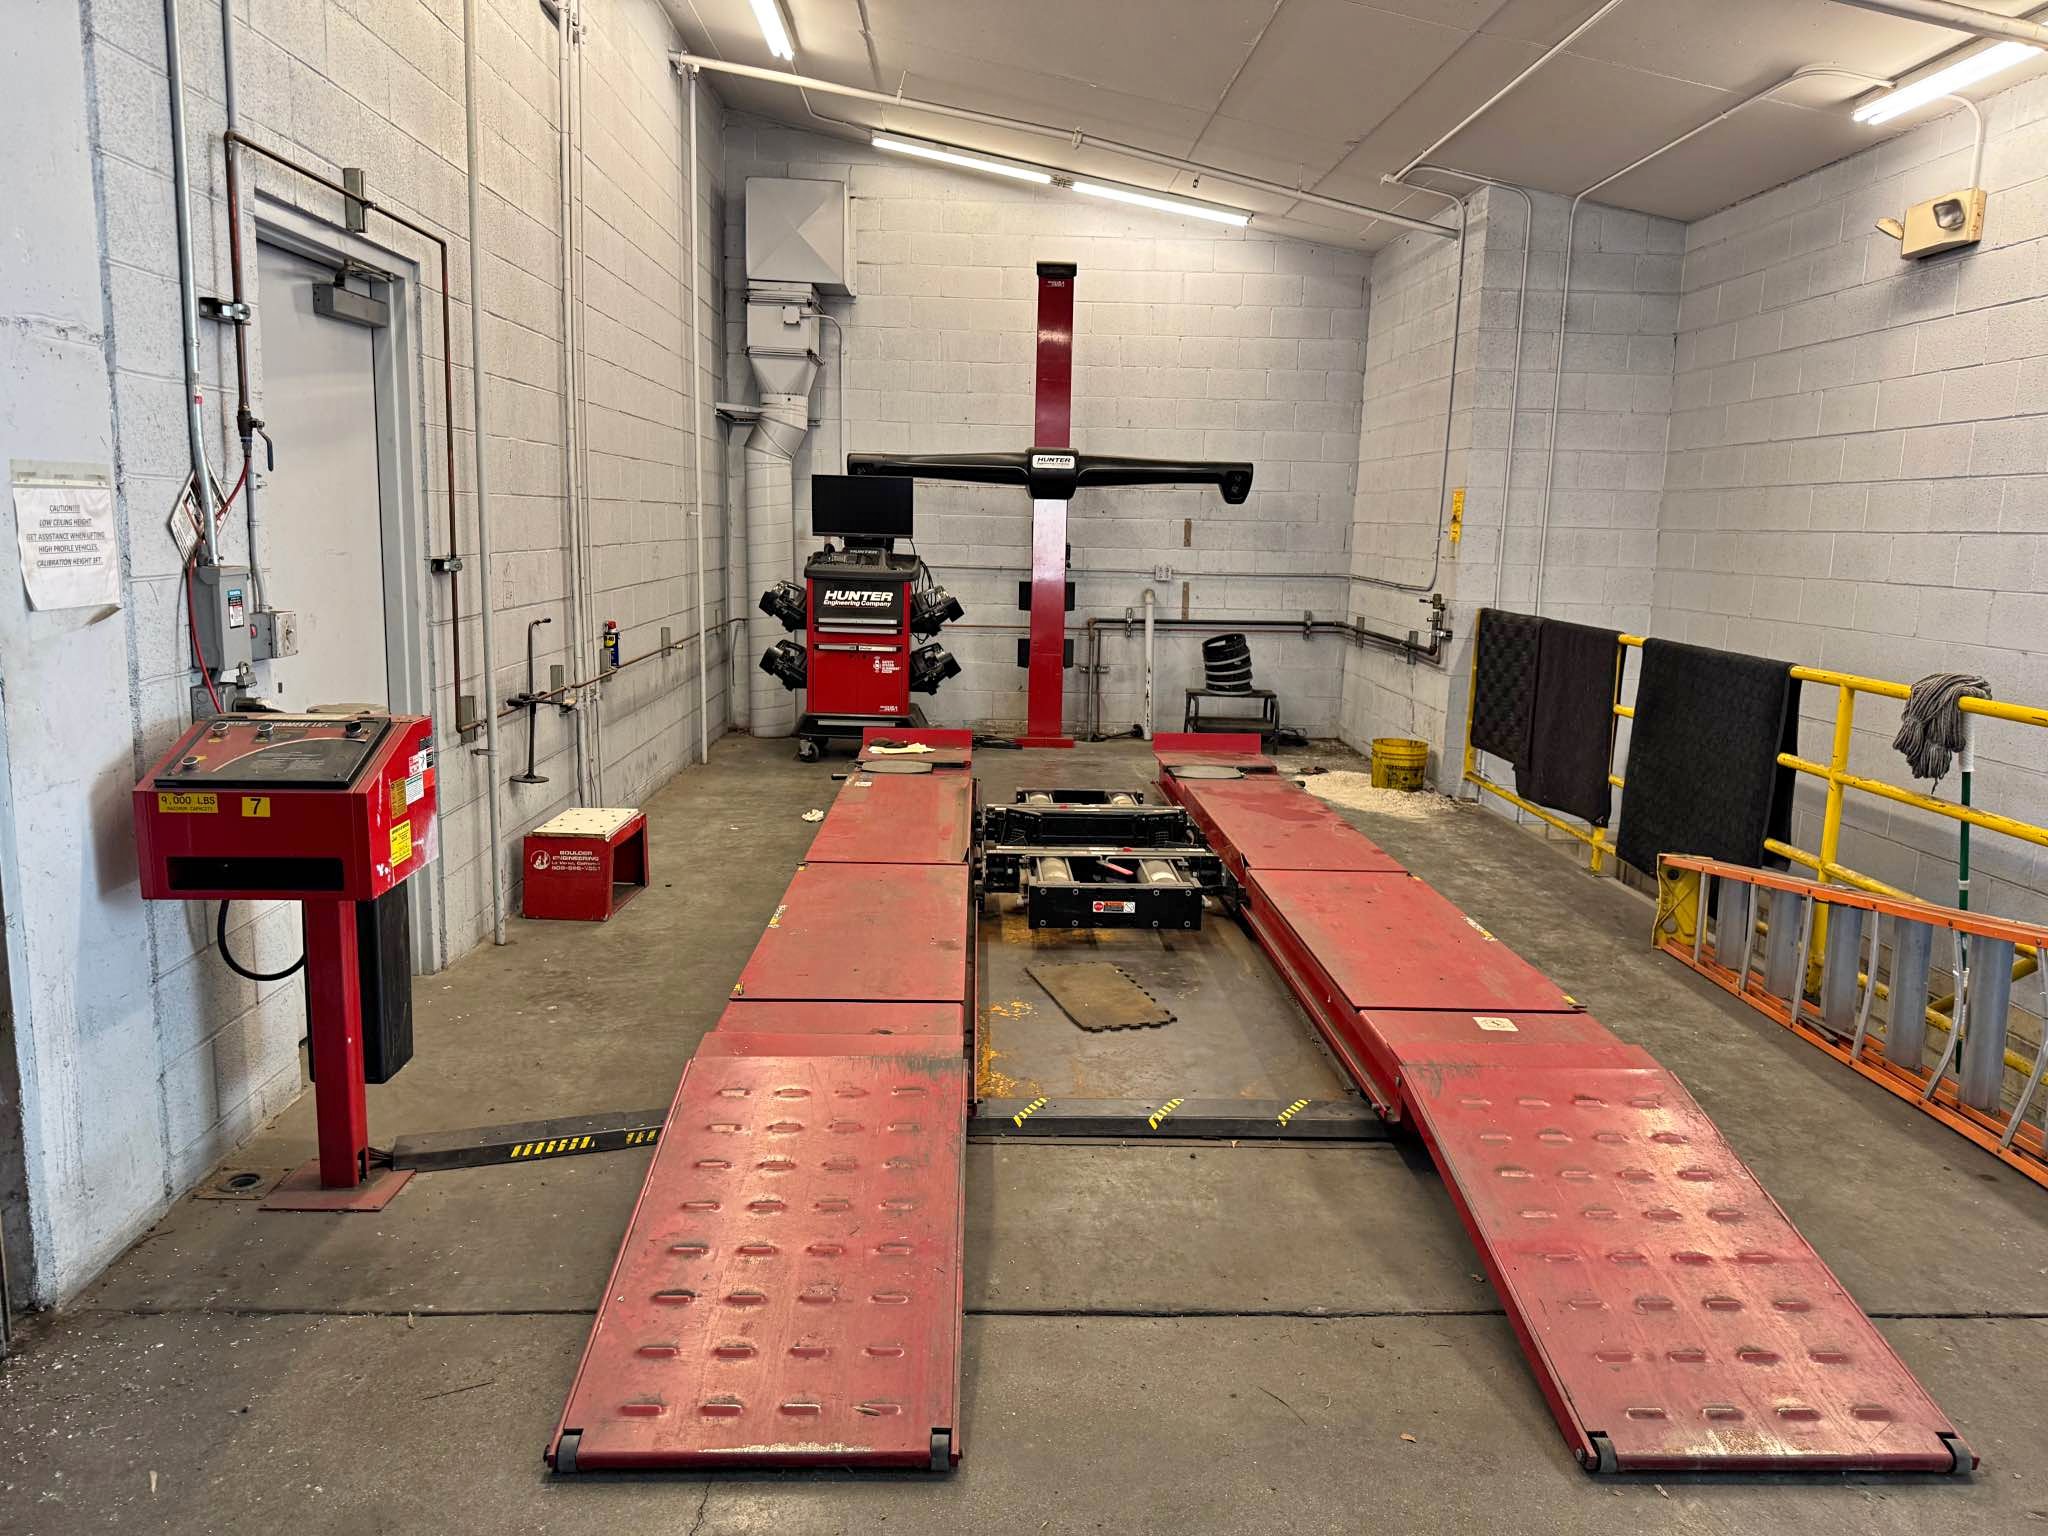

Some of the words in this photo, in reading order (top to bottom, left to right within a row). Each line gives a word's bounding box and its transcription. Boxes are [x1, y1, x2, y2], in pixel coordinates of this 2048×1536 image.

[74, 518, 92, 526] HEIGHT
[39, 545, 53, 553] HIGH
[37, 559, 72, 567] CALIBRATION
[72, 558, 91, 566] HEIGHT
[824, 590, 894, 602] HUNTER
[823, 599, 860, 608] Engineering
[861, 600, 892, 608] Company
[161, 796, 192, 806] 9,000
[197, 796, 216, 805] LBS
[250, 798, 262, 815] 7
